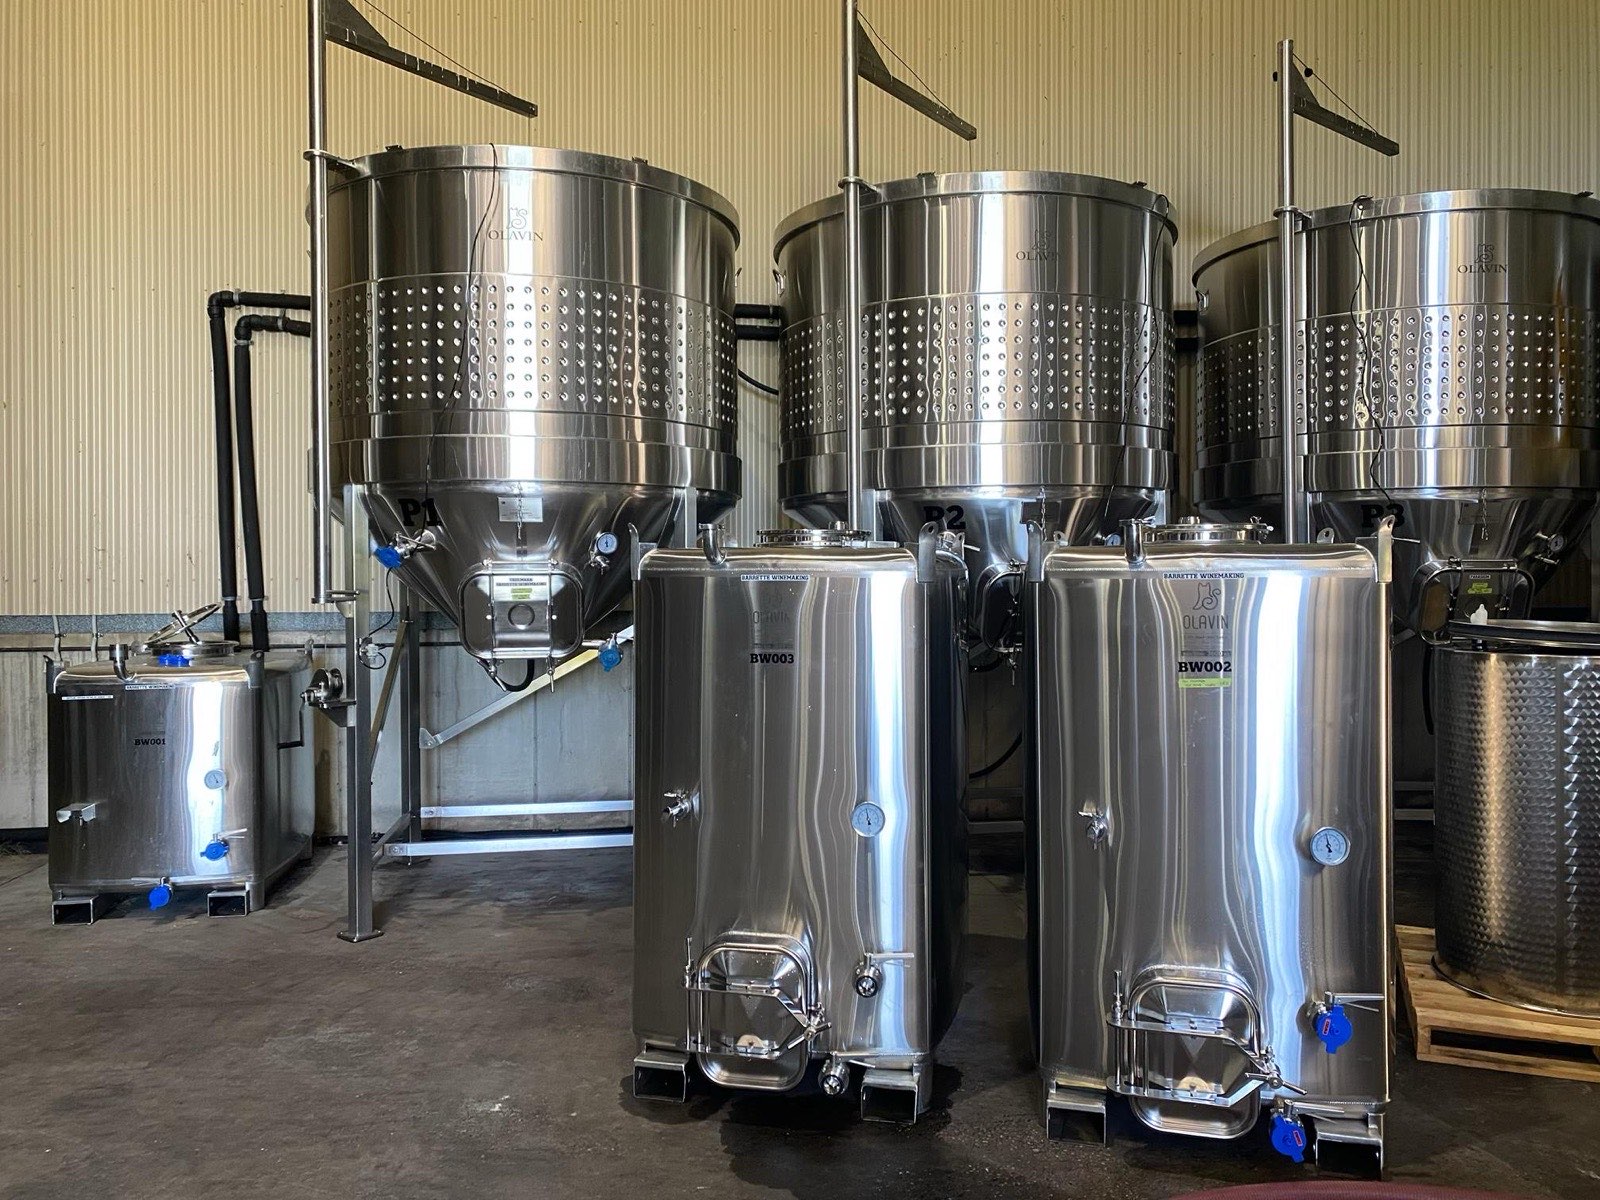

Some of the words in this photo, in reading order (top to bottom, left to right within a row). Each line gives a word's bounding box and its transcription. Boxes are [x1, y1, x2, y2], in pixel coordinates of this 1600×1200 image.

[488, 230, 543, 241] OLAVIN
[1457, 265, 1508, 273] OLAVIN
[398, 498, 440, 527] P1
[923, 505, 966, 529] P2
[1360, 504, 1405, 528] P3
[1183, 615, 1229, 629] OLAVIN
[750, 654, 794, 664] BW003
[1178, 661, 1232, 673] BW002
[134, 738, 166, 746] BW001
